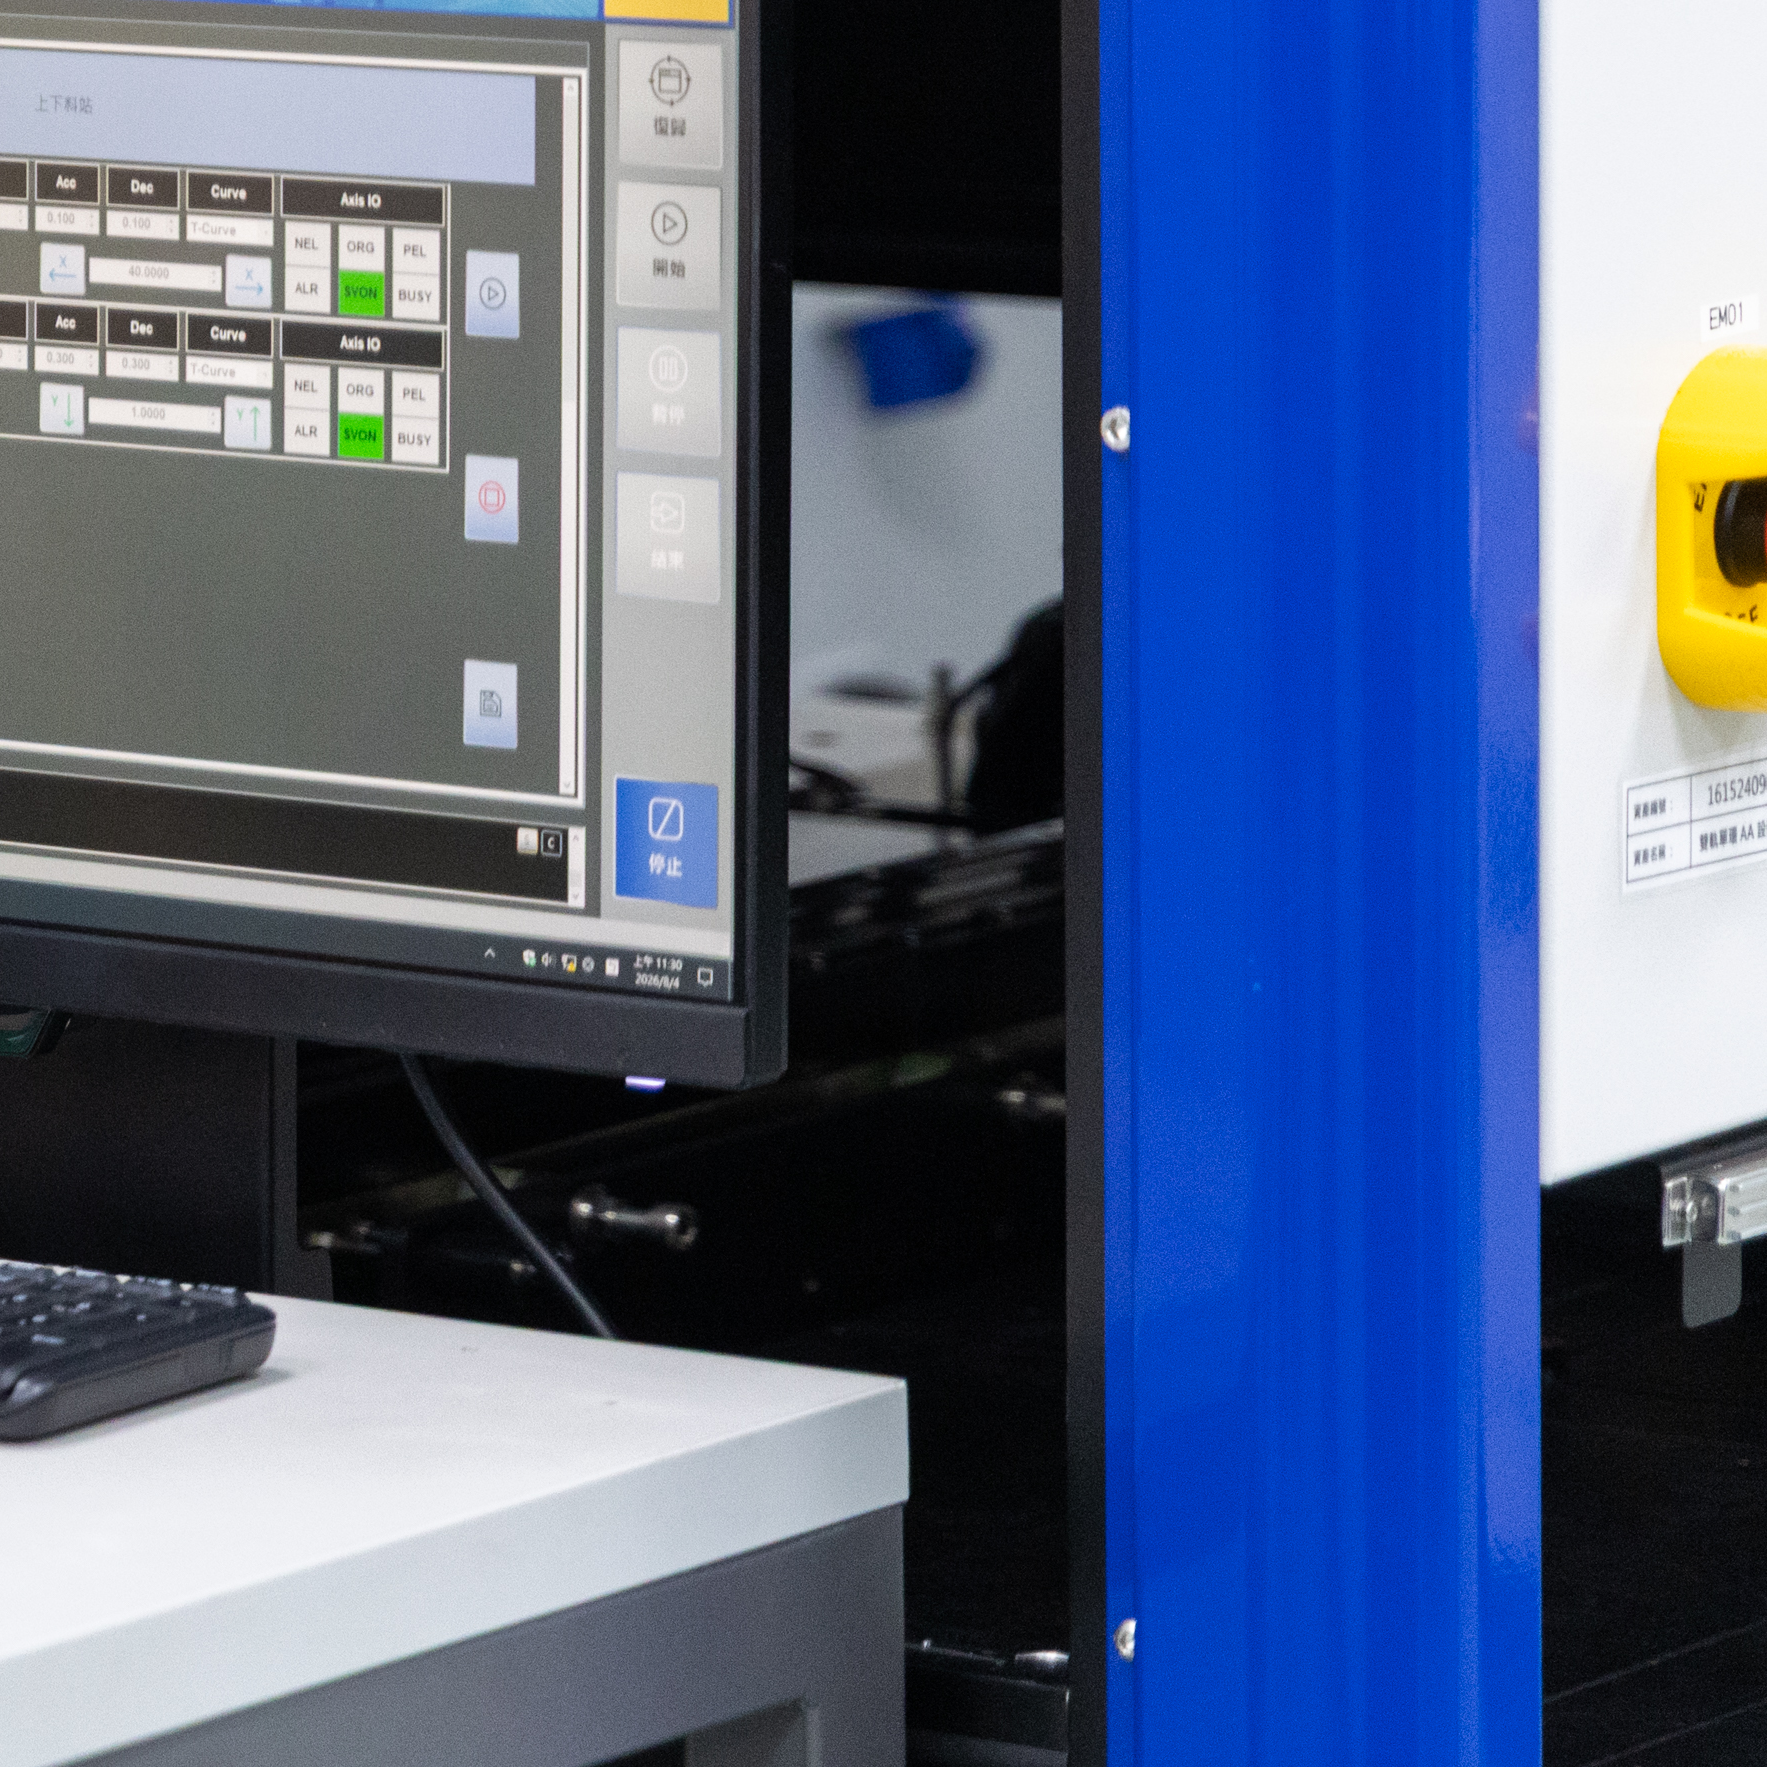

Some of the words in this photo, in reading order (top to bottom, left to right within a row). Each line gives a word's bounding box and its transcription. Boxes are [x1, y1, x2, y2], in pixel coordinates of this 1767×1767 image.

[56, 174, 77, 190] Acc
[131, 178, 154, 195] Dec
[210, 184, 247, 201] Curve
[340, 191, 365, 208] Axis
[367, 193, 382, 209] IO
[47, 210, 75, 226] 0.100
[122, 216, 151, 230] 0.100
[190, 220, 237, 238] T-Curve
[294, 237, 319, 251] NEL
[346, 240, 375, 255] ORG
[403, 243, 427, 258] PEL
[58, 255, 67, 267] X
[128, 264, 170, 279] 40.0000
[244, 268, 254, 281] X
[295, 281, 318, 296] ALR
[344, 285, 378, 300] SVON
[398, 288, 432, 303] BUSY
[55, 314, 77, 330] Acc
[1709, 301, 1743, 330] EM01
[130, 320, 154, 336] Dec
[210, 326, 247, 342] Curve
[339, 334, 365, 351] Axis
[367, 336, 381, 352] IO
[46, 351, 75, 366] 0.300
[122, 356, 151, 370] 0.300
[190, 361, 236, 378] T-Curve
[294, 379, 318, 393] NEL
[346, 383, 374, 397] ORG
[402, 387, 426, 402] PEL
[131, 406, 166, 421] 1.0000
[294, 424, 318, 438] ALR
[397, 432, 431, 447] BUSY
[1708, 773, 1767, 806] 16152409
[1740, 823, 1755, 841] AA
[1757, 819, 1767, 839] 設
[648, 853, 683, 878] 停止
